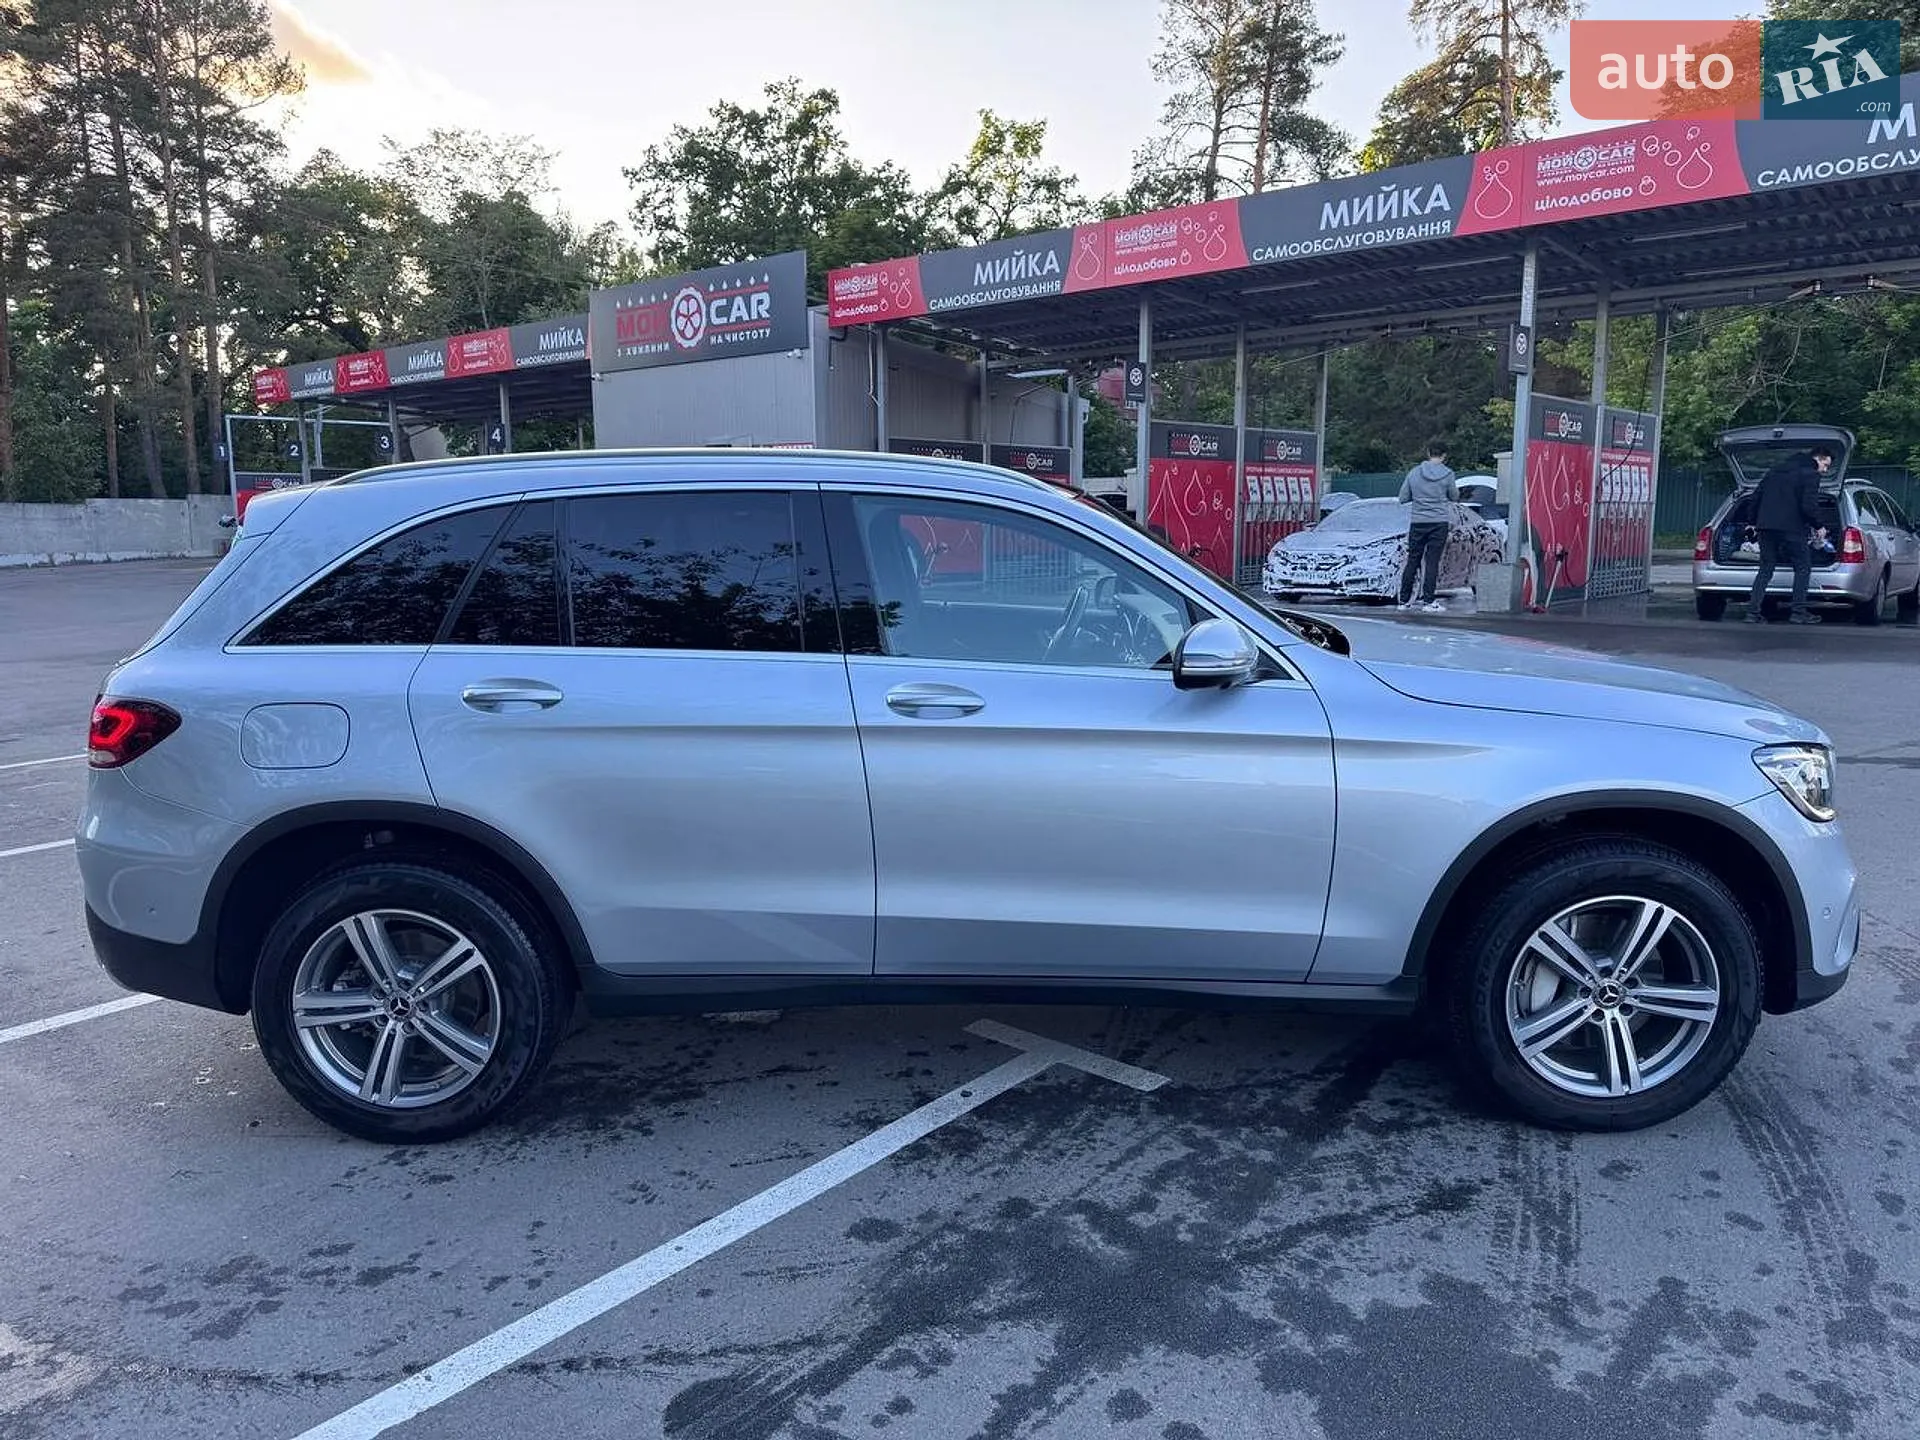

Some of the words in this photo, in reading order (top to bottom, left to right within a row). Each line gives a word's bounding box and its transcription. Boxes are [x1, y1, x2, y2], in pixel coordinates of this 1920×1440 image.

[1598, 146, 1635, 160] CAR
[1537, 165, 1635, 187] www.moycar.com
[1319, 183, 1452, 231] МИЙКА
[1252, 219, 1451, 261] САМООБСЛУГОВУВАННЯ
[973, 250, 1061, 286] МИЙКА
[929, 280, 1061, 310] САМООБСЛУГОВУВАННЯ
[709, 292, 771, 325] CAR
[539, 326, 585, 351] МИЙКА
[380, 436, 390, 448] 3
[492, 428, 501, 441] 4
[219, 446, 225, 457] 1
[290, 444, 299, 456] 2
